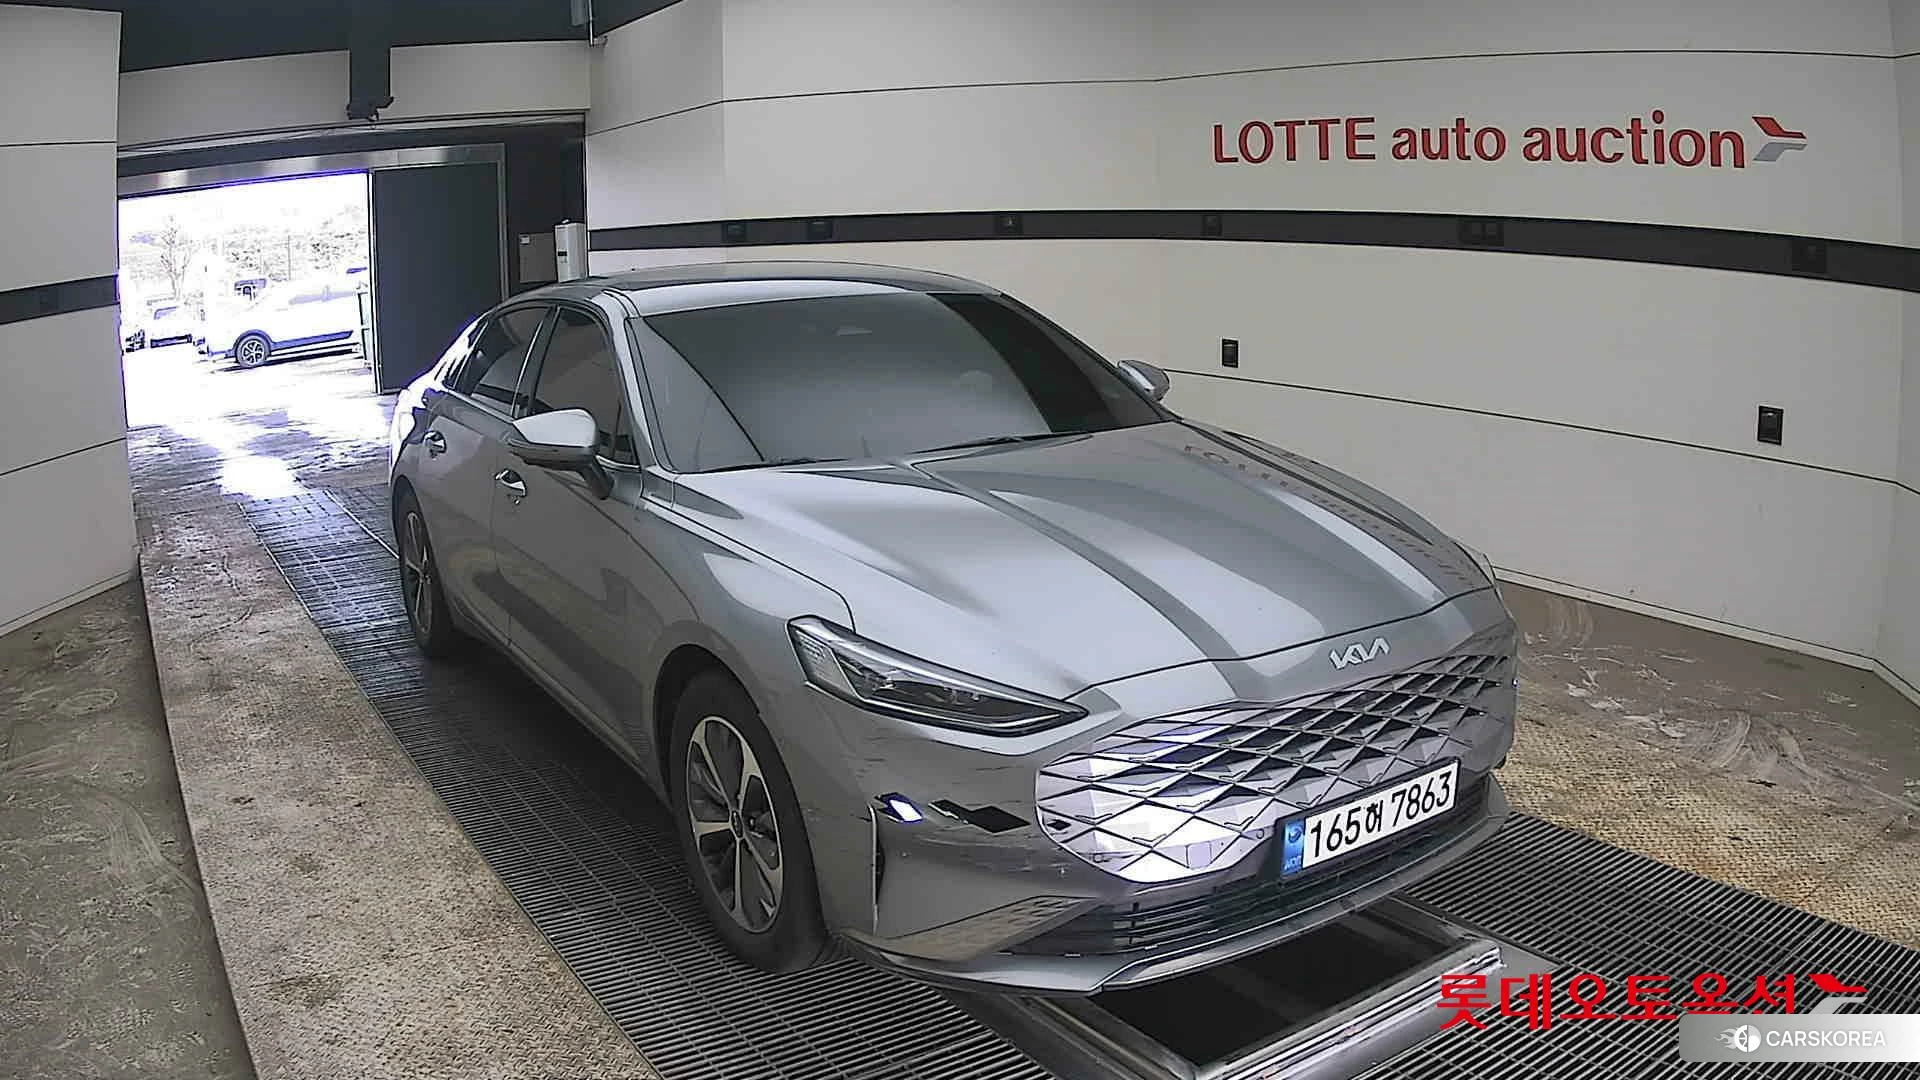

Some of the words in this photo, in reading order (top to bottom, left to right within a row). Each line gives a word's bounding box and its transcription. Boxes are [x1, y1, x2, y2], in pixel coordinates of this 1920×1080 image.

[1212, 116, 1376, 164] LOTTE
[1391, 117, 1506, 162] auto
[1522, 109, 1746, 169] auction
[1310, 800, 1384, 858] 165허
[1391, 770, 1453, 828] 7863
